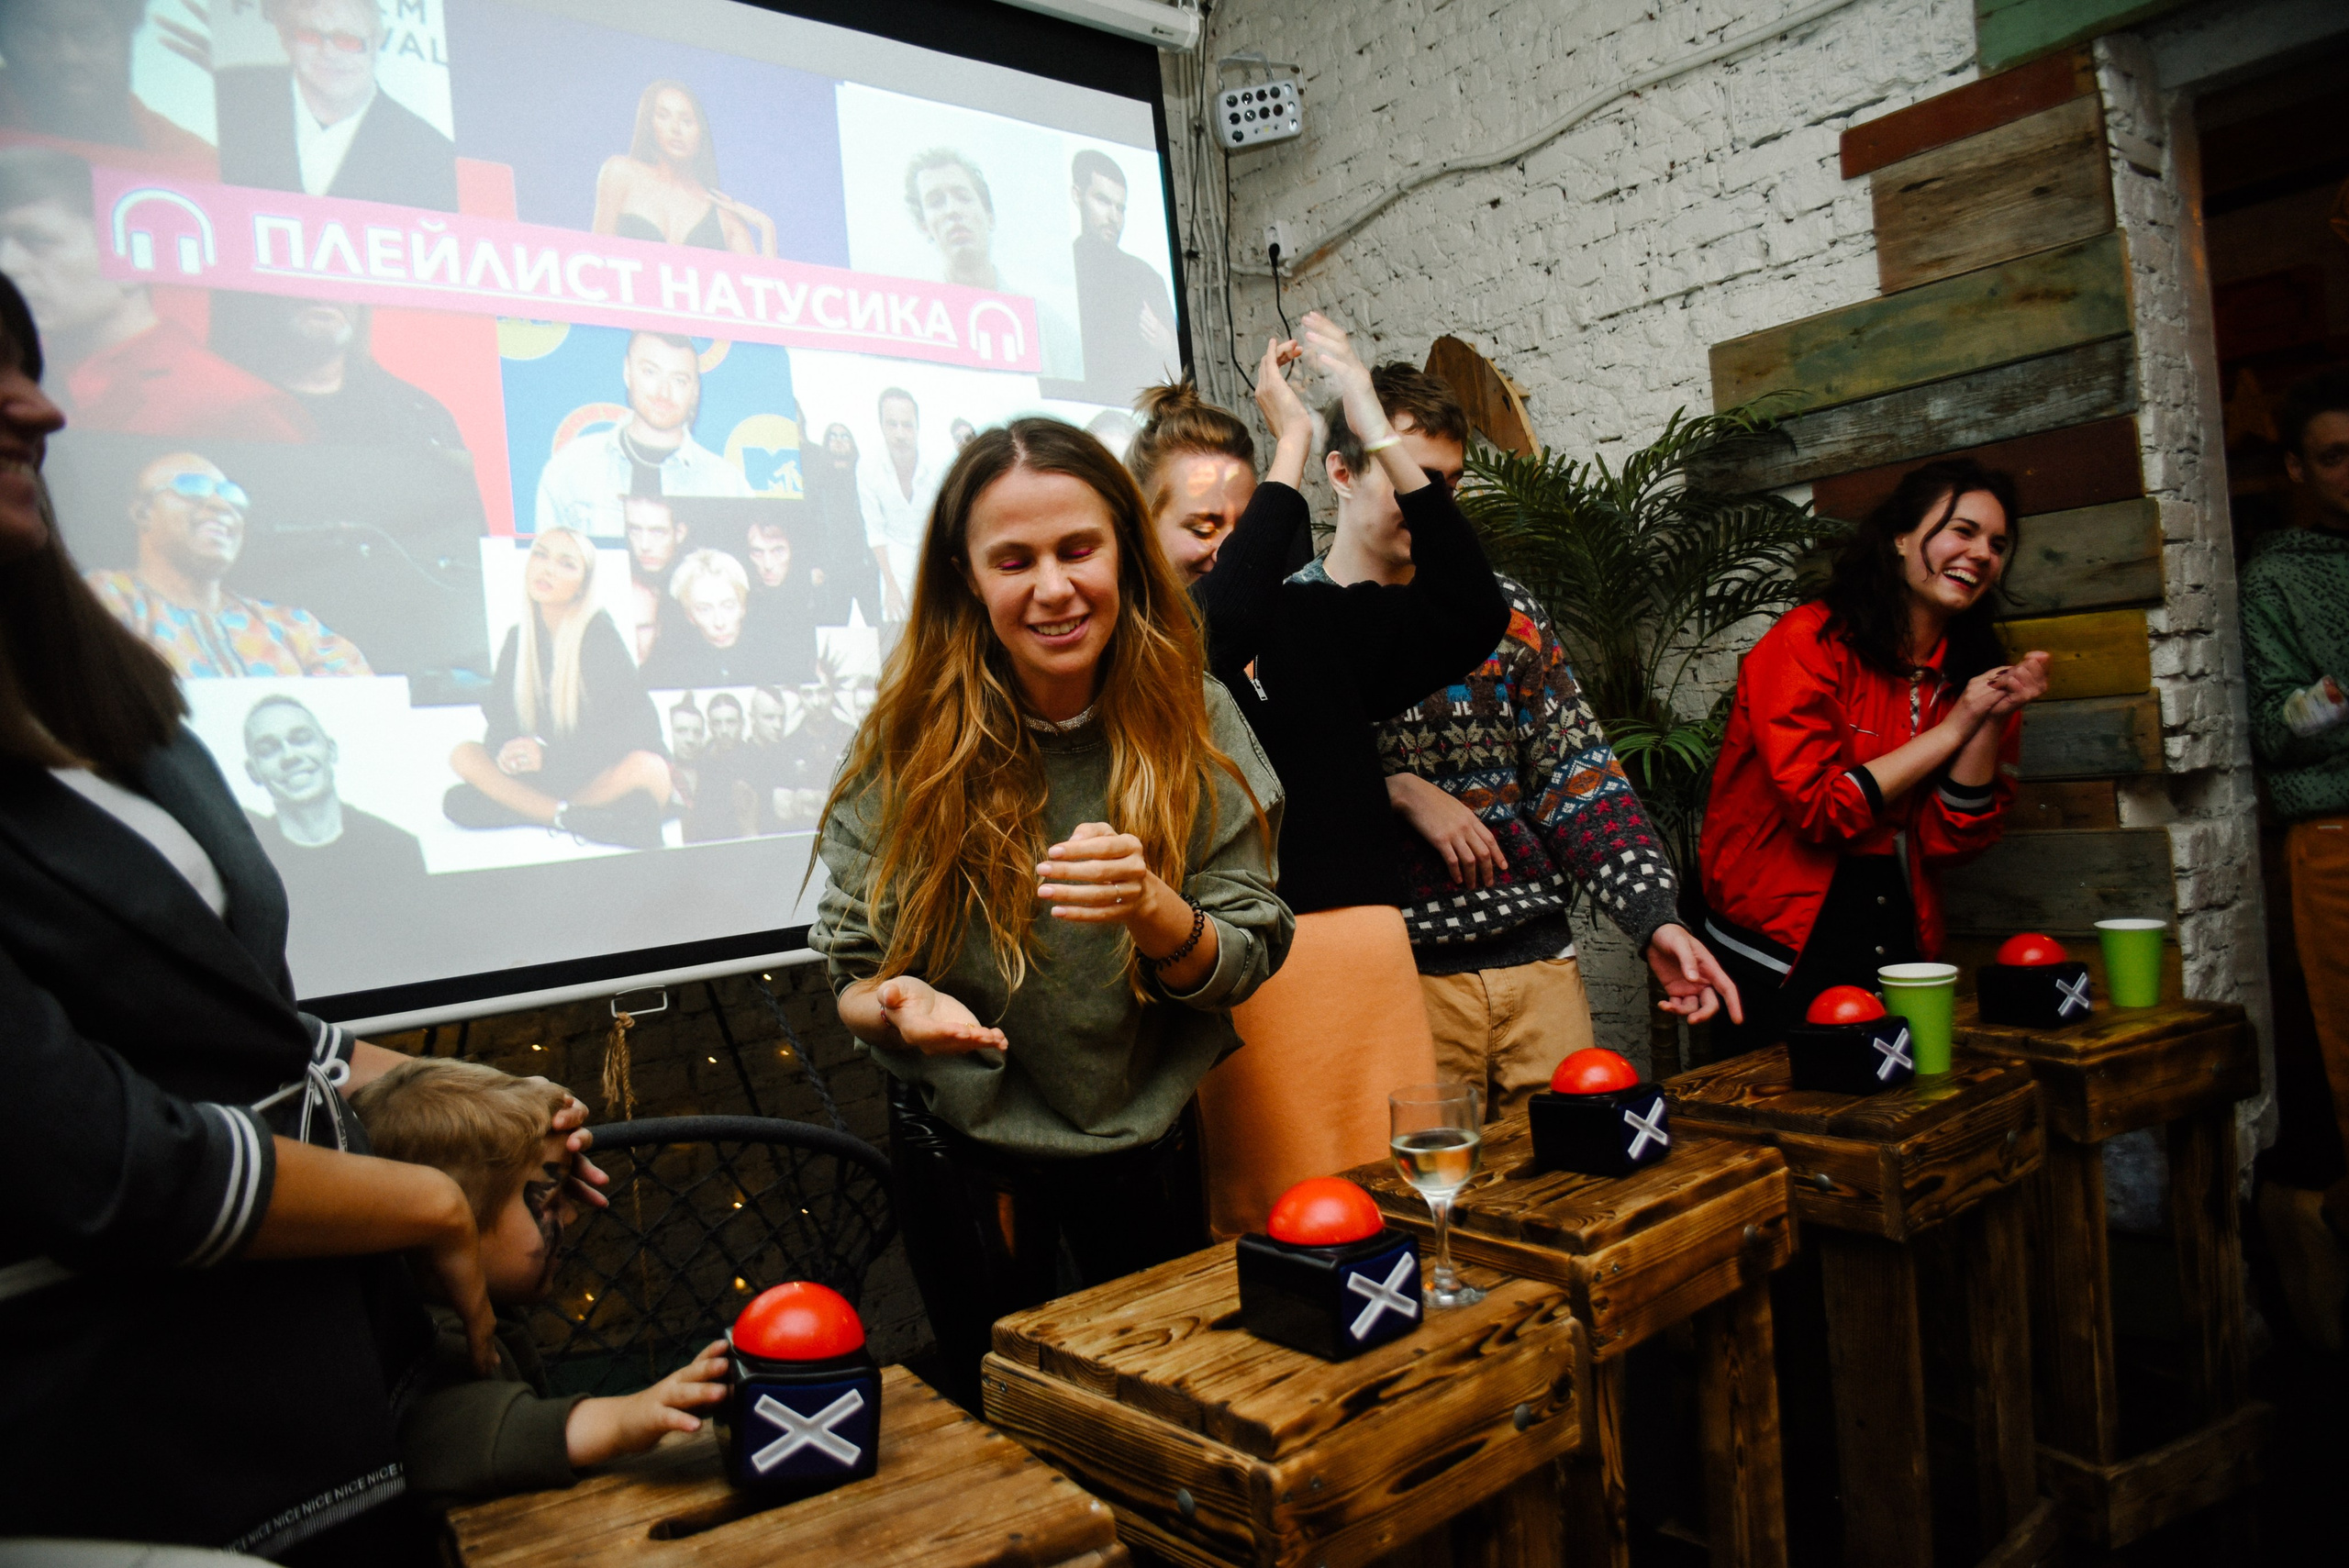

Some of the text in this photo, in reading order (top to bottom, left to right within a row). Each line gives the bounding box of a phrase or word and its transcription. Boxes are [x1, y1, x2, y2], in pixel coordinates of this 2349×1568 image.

[253, 214, 960, 343] ПЛЕЙЛИСТ НАТУСИКА
[301, 1491, 334, 1517] NICE
[334, 1476, 366, 1501] NICE
[367, 1462, 398, 1486] NICE
